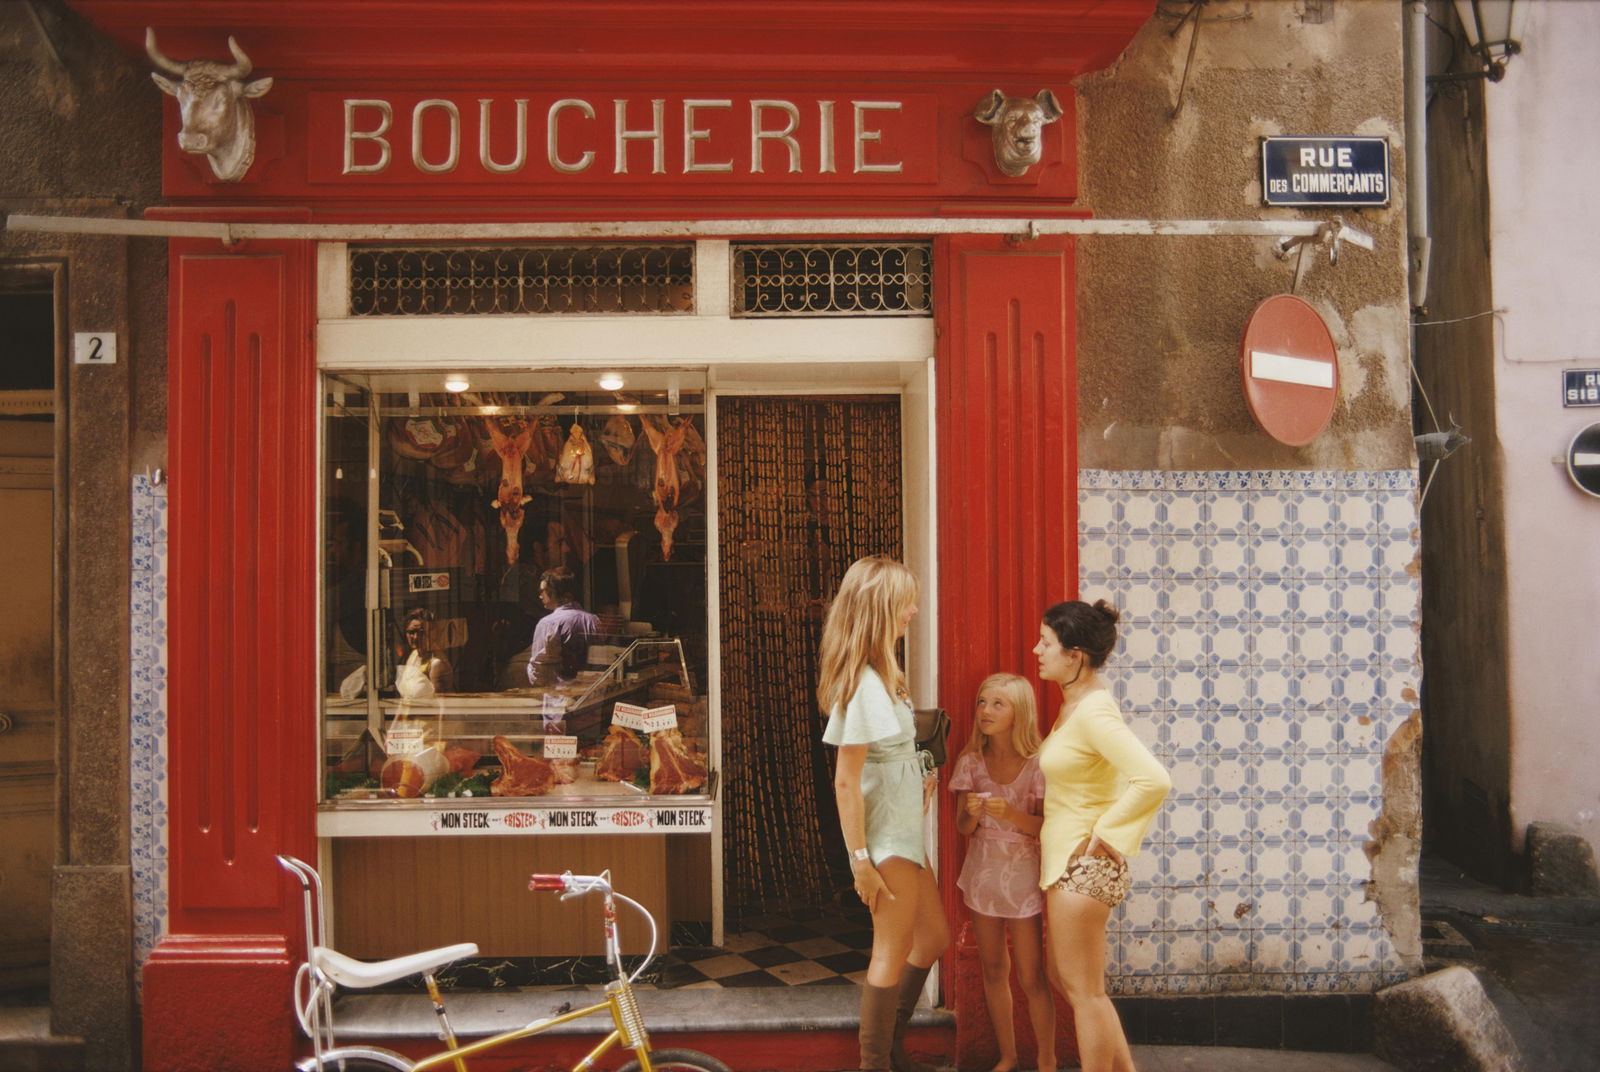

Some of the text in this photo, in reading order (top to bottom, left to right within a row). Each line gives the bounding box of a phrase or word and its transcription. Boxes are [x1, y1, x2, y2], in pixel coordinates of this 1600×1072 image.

[342, 98, 904, 175] BOUCHERIE
[1300, 147, 1353, 168] RUE
[1270, 173, 1384, 195] DES COMMERÇANTS
[88, 336, 104, 360] 2
[441, 812, 461, 828] MON
[462, 812, 490, 828] STECK
[549, 811, 569, 827] MON
[570, 811, 598, 827] STECK
[656, 810, 677, 826] MON
[678, 810, 706, 826] STECK
